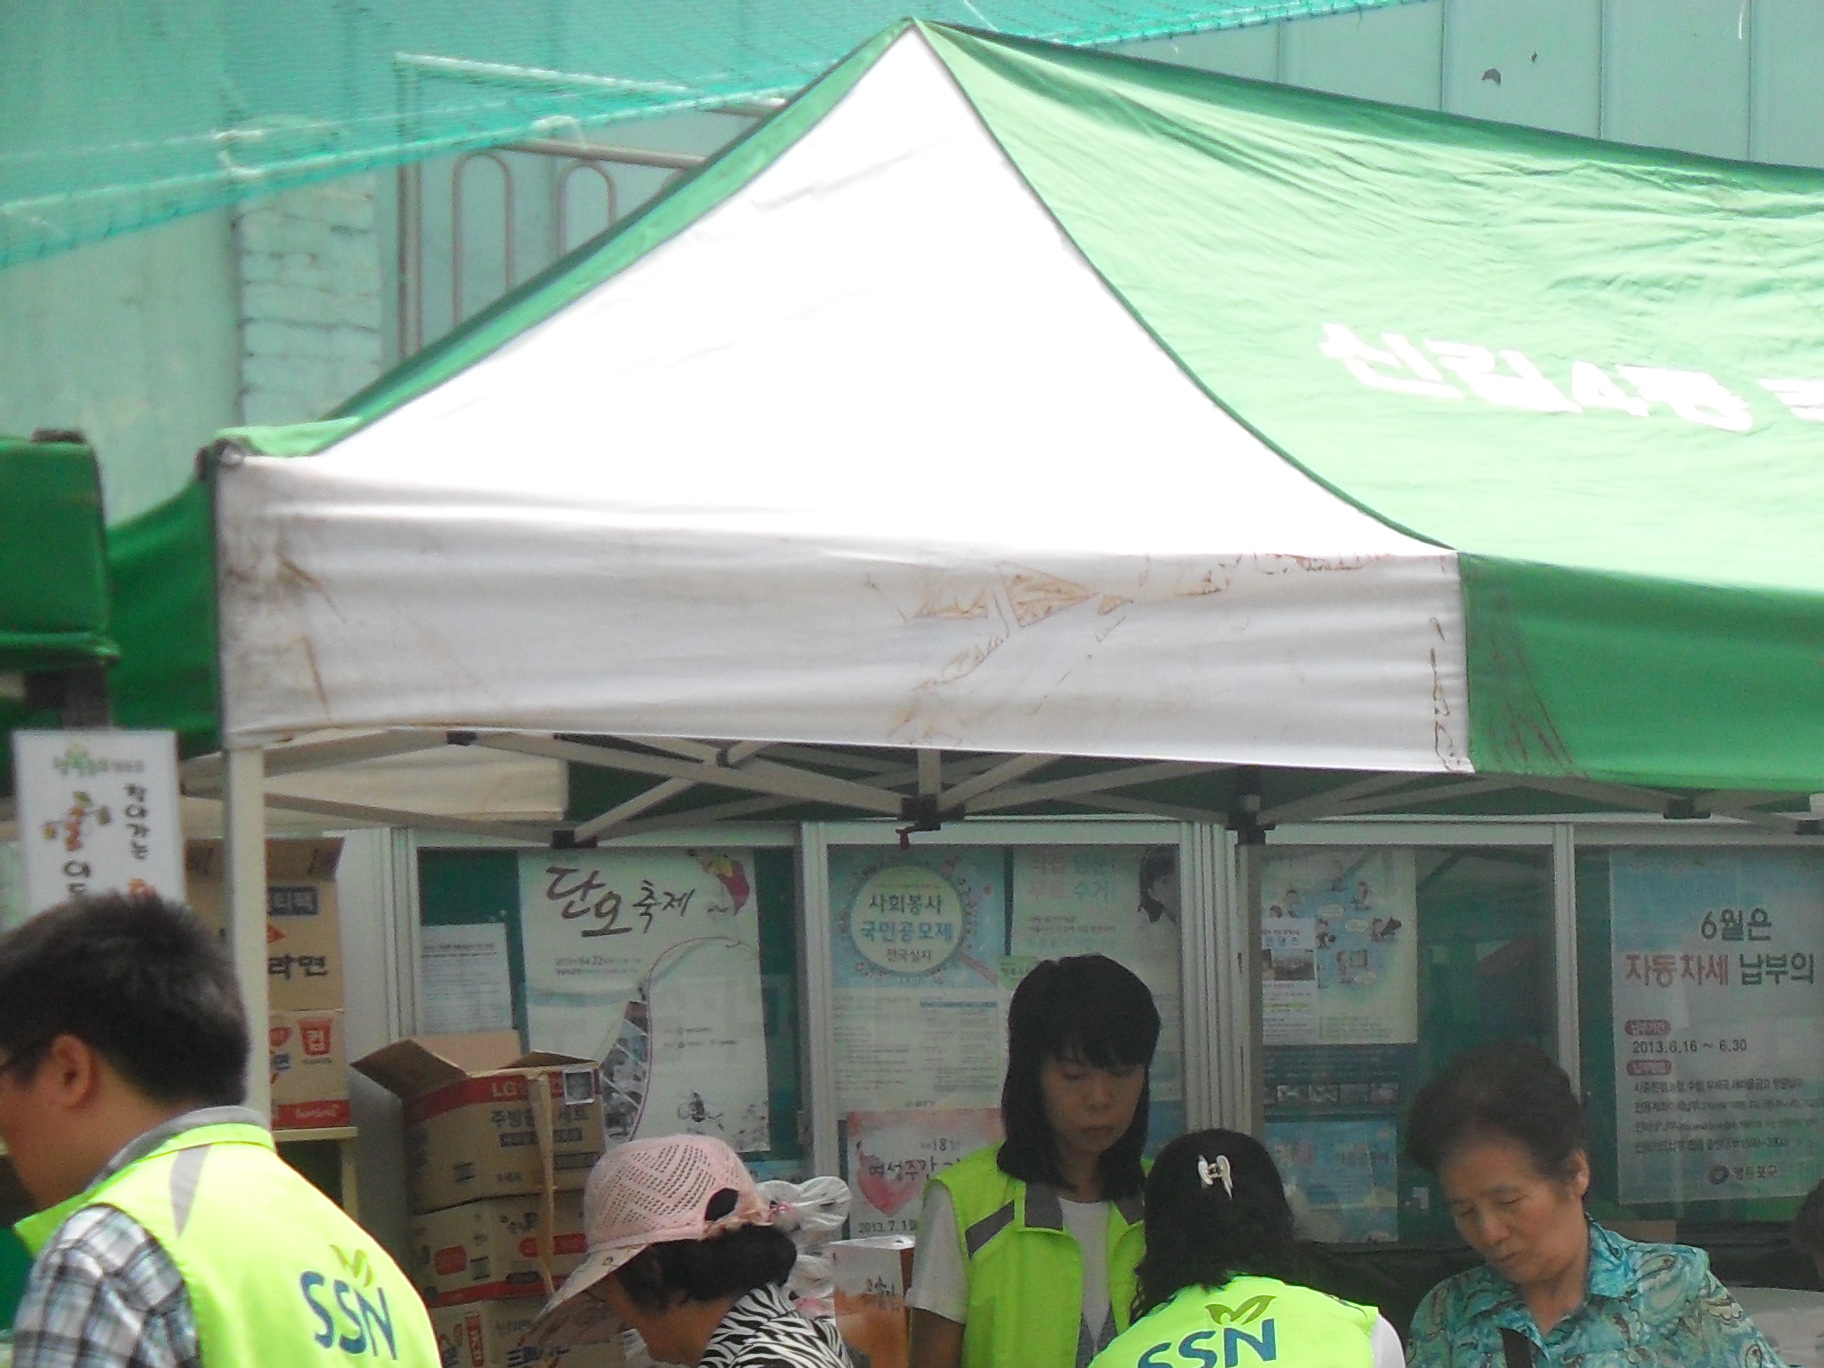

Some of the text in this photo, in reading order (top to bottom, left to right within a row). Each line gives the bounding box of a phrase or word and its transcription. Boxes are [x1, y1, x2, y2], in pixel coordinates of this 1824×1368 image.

[869, 893, 943, 916] 사회봉사
[861, 920, 953, 943] 국민공모제
[1701, 907, 1773, 942] 6월은
[1625, 953, 1729, 988] 자동차세
[1740, 952, 1814, 985] 납부의
[1632, 1040, 1697, 1054] 2013.6.16
[1719, 1039, 1747, 1052] 6.30
[299, 1270, 398, 1361] SSN
